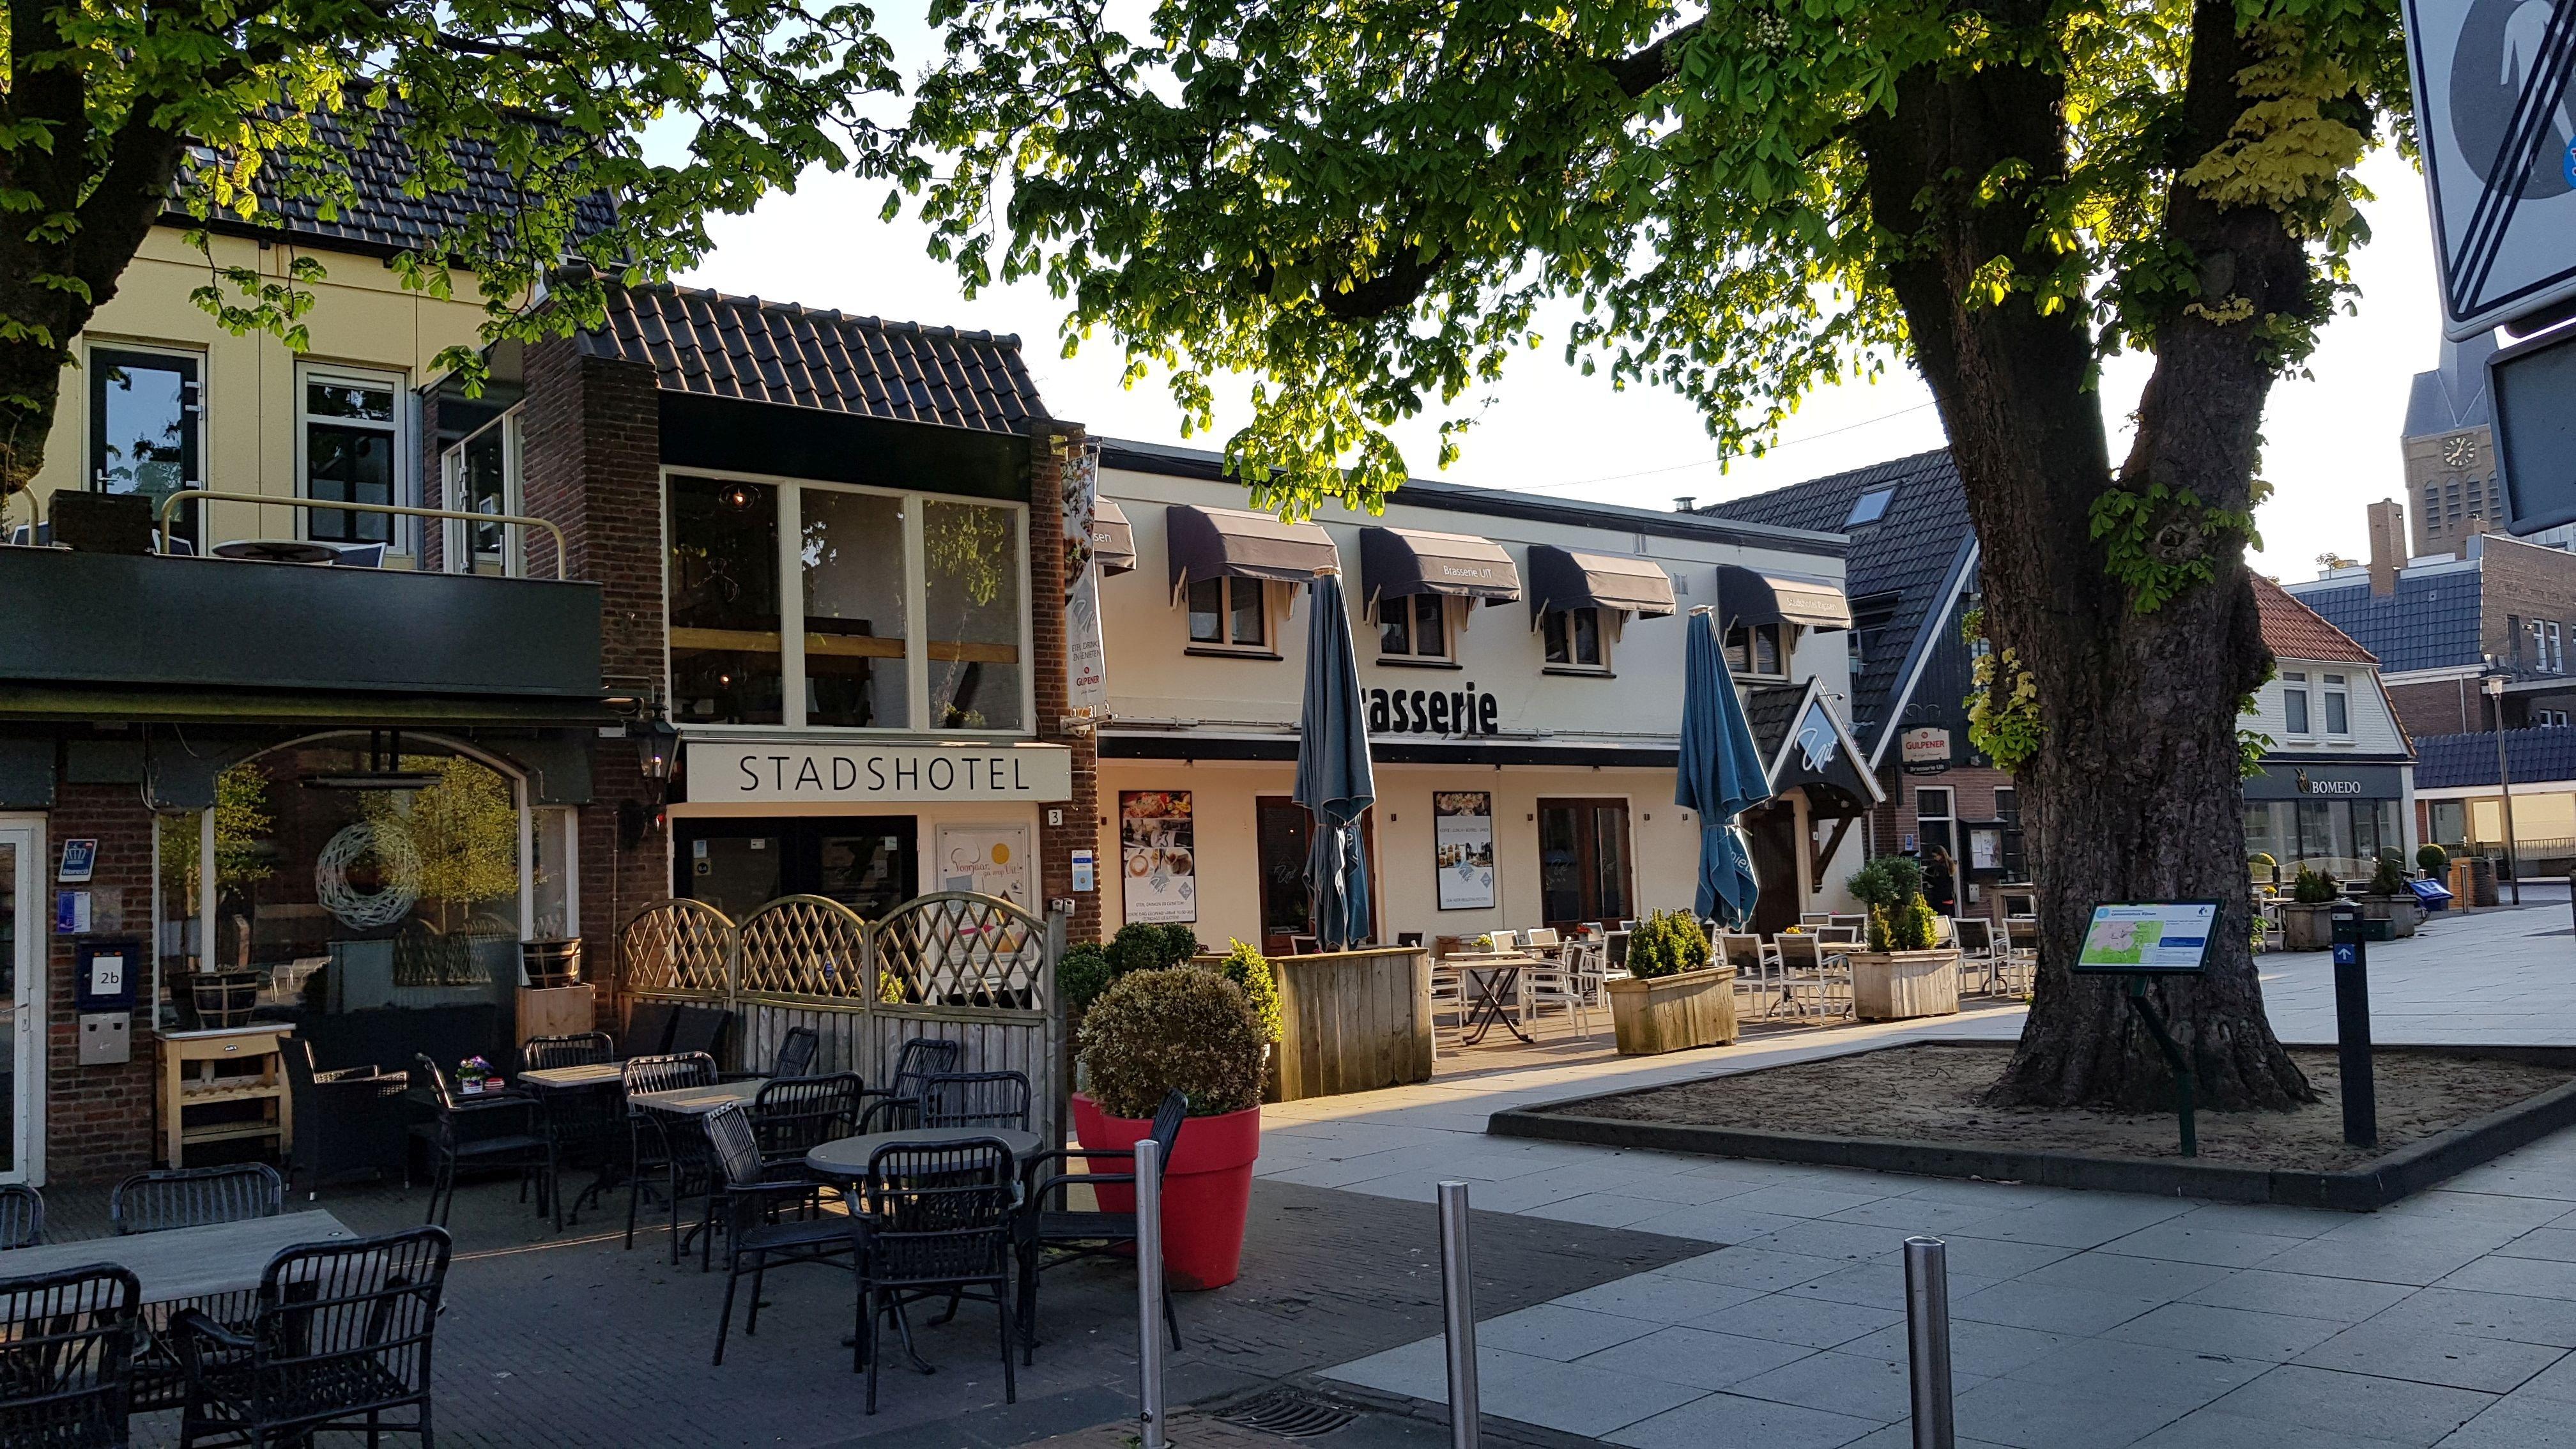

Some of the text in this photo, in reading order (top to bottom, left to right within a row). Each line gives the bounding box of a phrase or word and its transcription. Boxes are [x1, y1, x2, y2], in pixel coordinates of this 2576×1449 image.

[1443, 565, 1492, 578] Brasserie UIT
[1794, 727, 1838, 774] Uit
[1906, 740, 1945, 750] GULPENER
[740, 756, 1030, 791] STADSHOTEL
[2312, 781, 2361, 793] BOMEDO
[1052, 811, 1058, 824] 3
[100, 972, 119, 984] 2b
